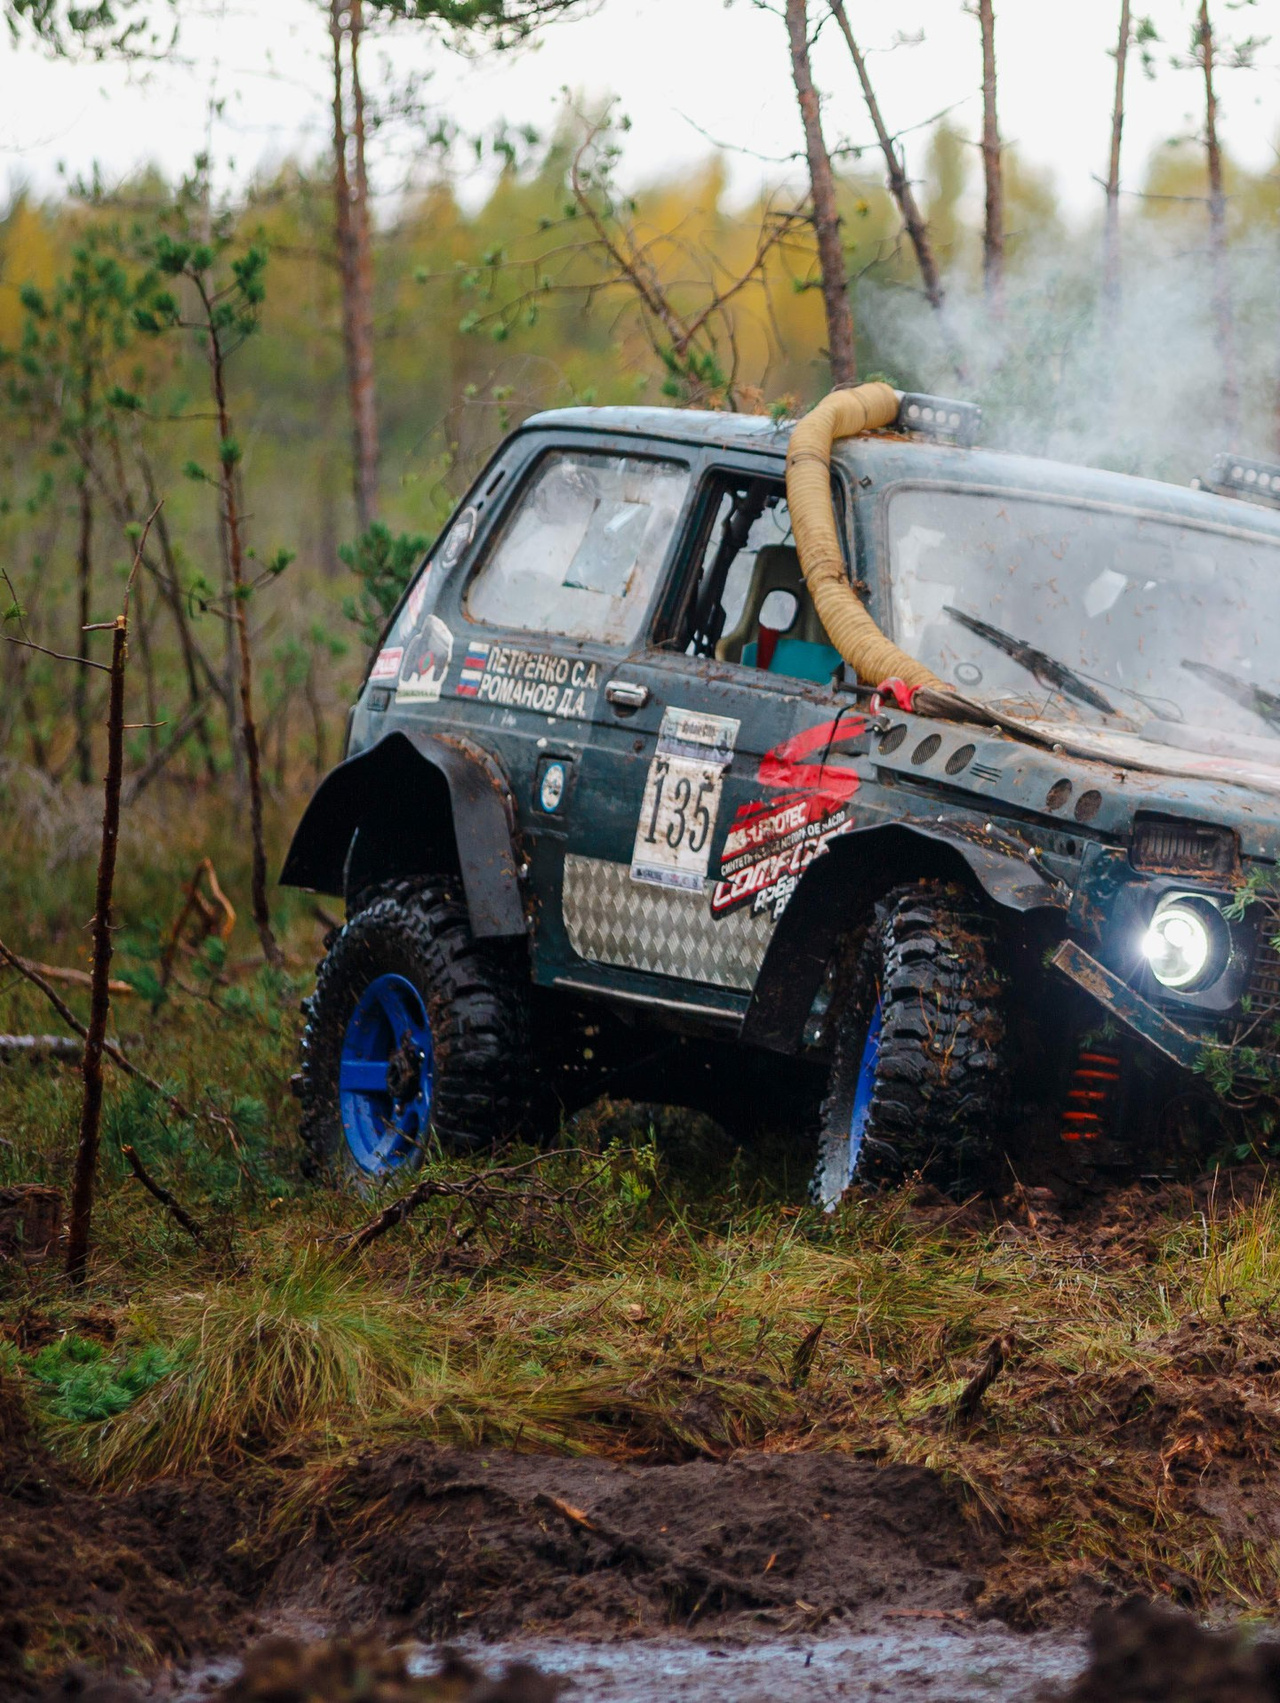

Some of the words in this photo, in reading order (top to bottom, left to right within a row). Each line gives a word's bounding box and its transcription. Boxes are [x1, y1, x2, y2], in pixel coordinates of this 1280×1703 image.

[486, 646, 570, 684] ПЕТРЕНКО
[571, 660, 599, 690] С.А.
[477, 673, 559, 711] РОМАНОВ
[556, 687, 587, 718] Д.А.
[644, 763, 716, 853] 135
